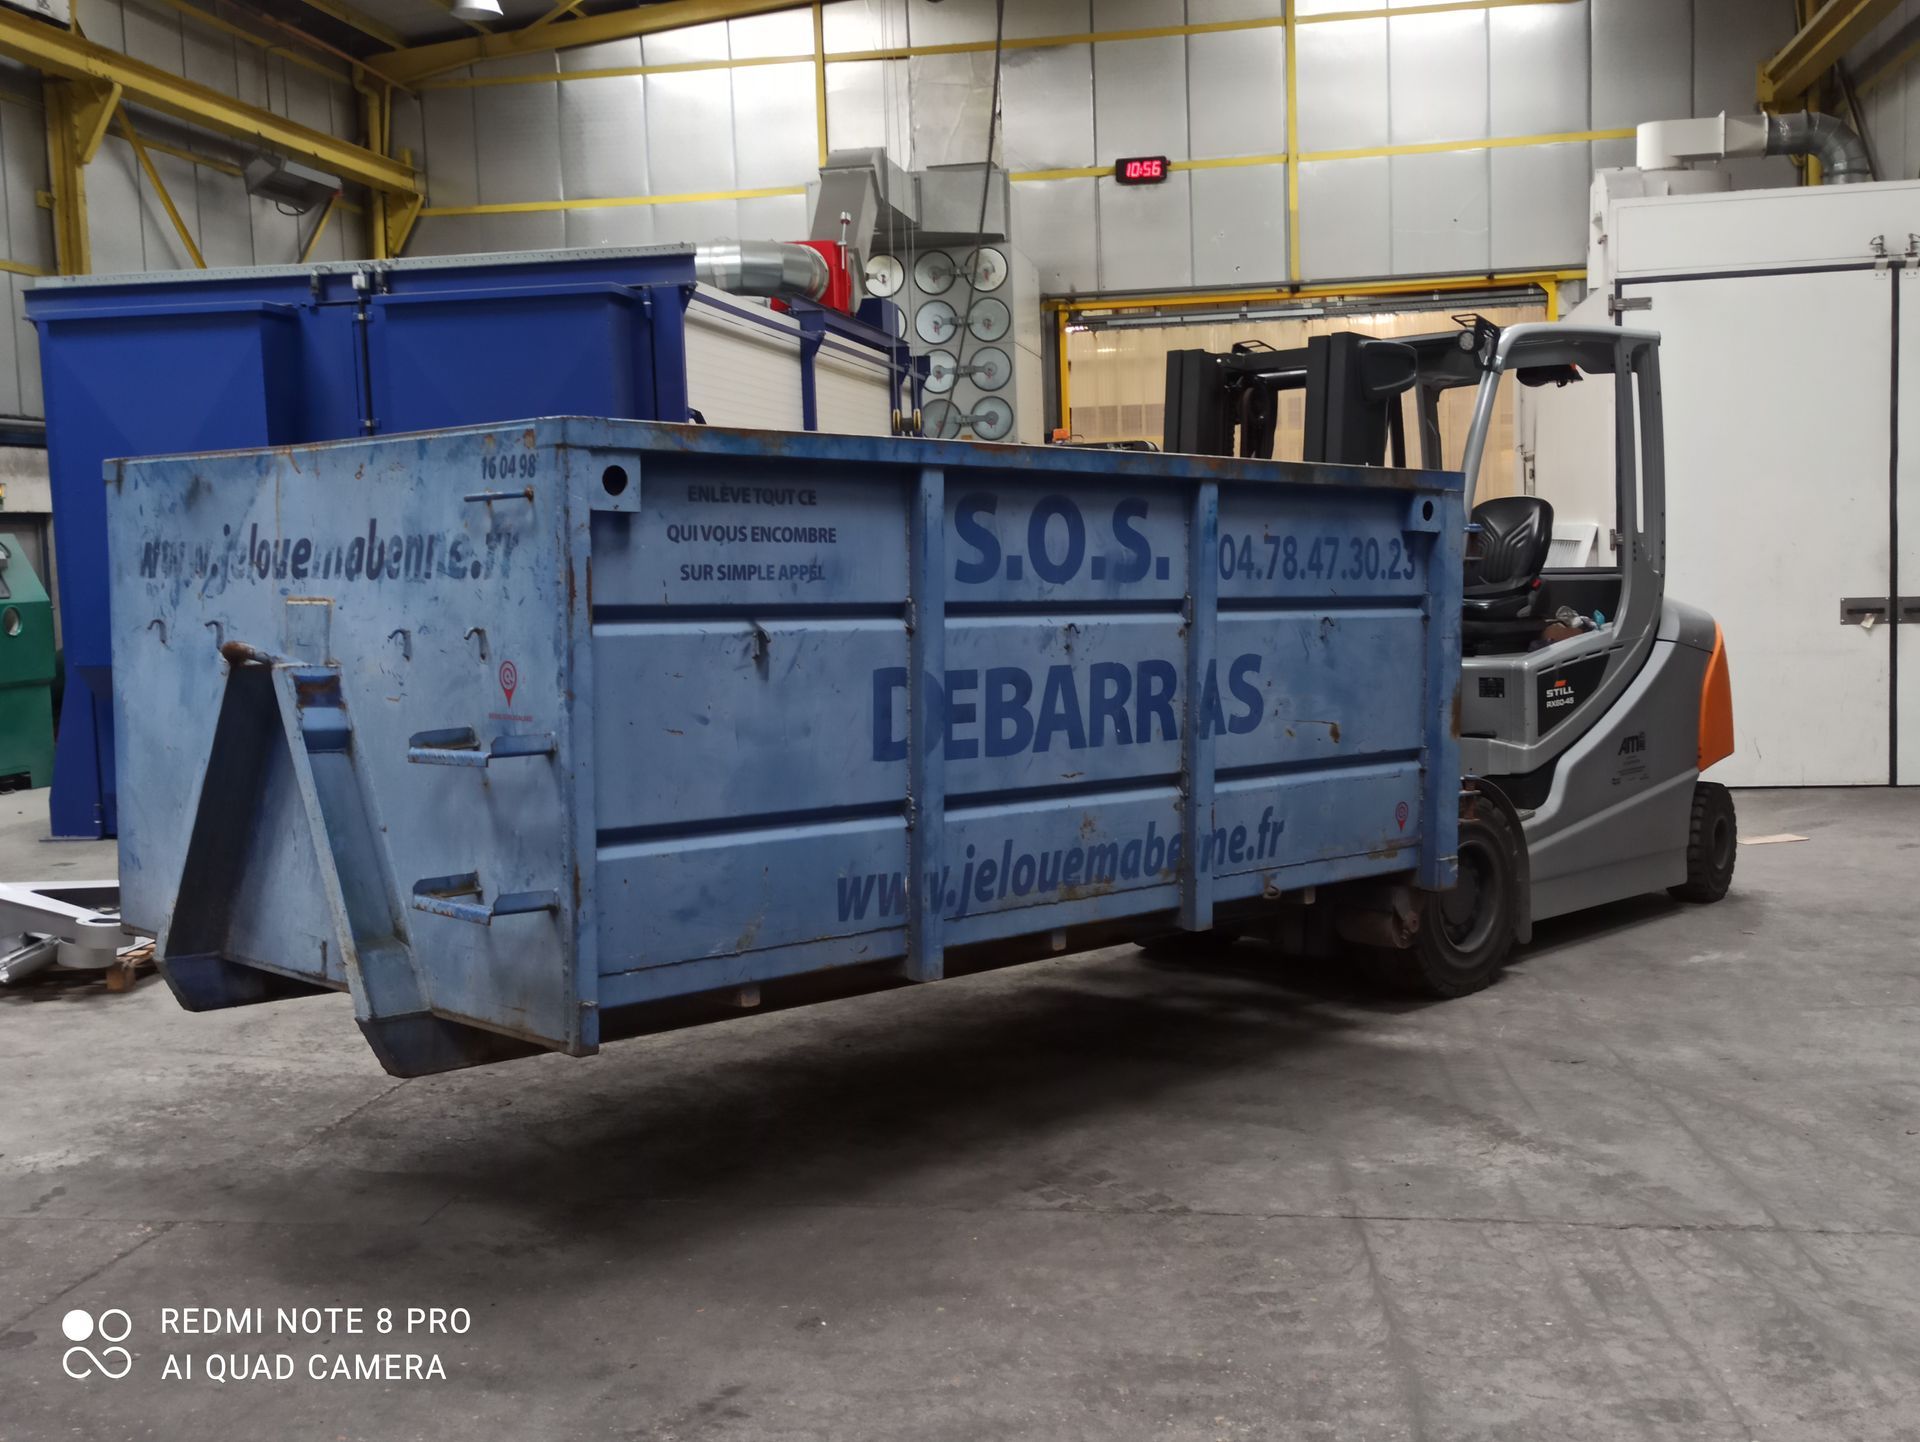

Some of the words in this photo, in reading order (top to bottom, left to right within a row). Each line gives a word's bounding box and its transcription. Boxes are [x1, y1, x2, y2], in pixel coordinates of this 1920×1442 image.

[1126, 161, 1163, 178] 10:56
[752, 487, 796, 506] TOUT
[797, 489, 817, 506] CE
[668, 524, 698, 544] QUI
[701, 525, 748, 543] VOUS
[751, 526, 837, 544] ENCOMBRE
[954, 491, 1170, 585] S.O.S.
[680, 563, 714, 581] SUR
[717, 564, 775, 581] SIMPLE
[778, 564, 826, 582] APPEL
[1546, 686, 1575, 698] STILL
[872, 653, 1265, 762] DEBARRAS
